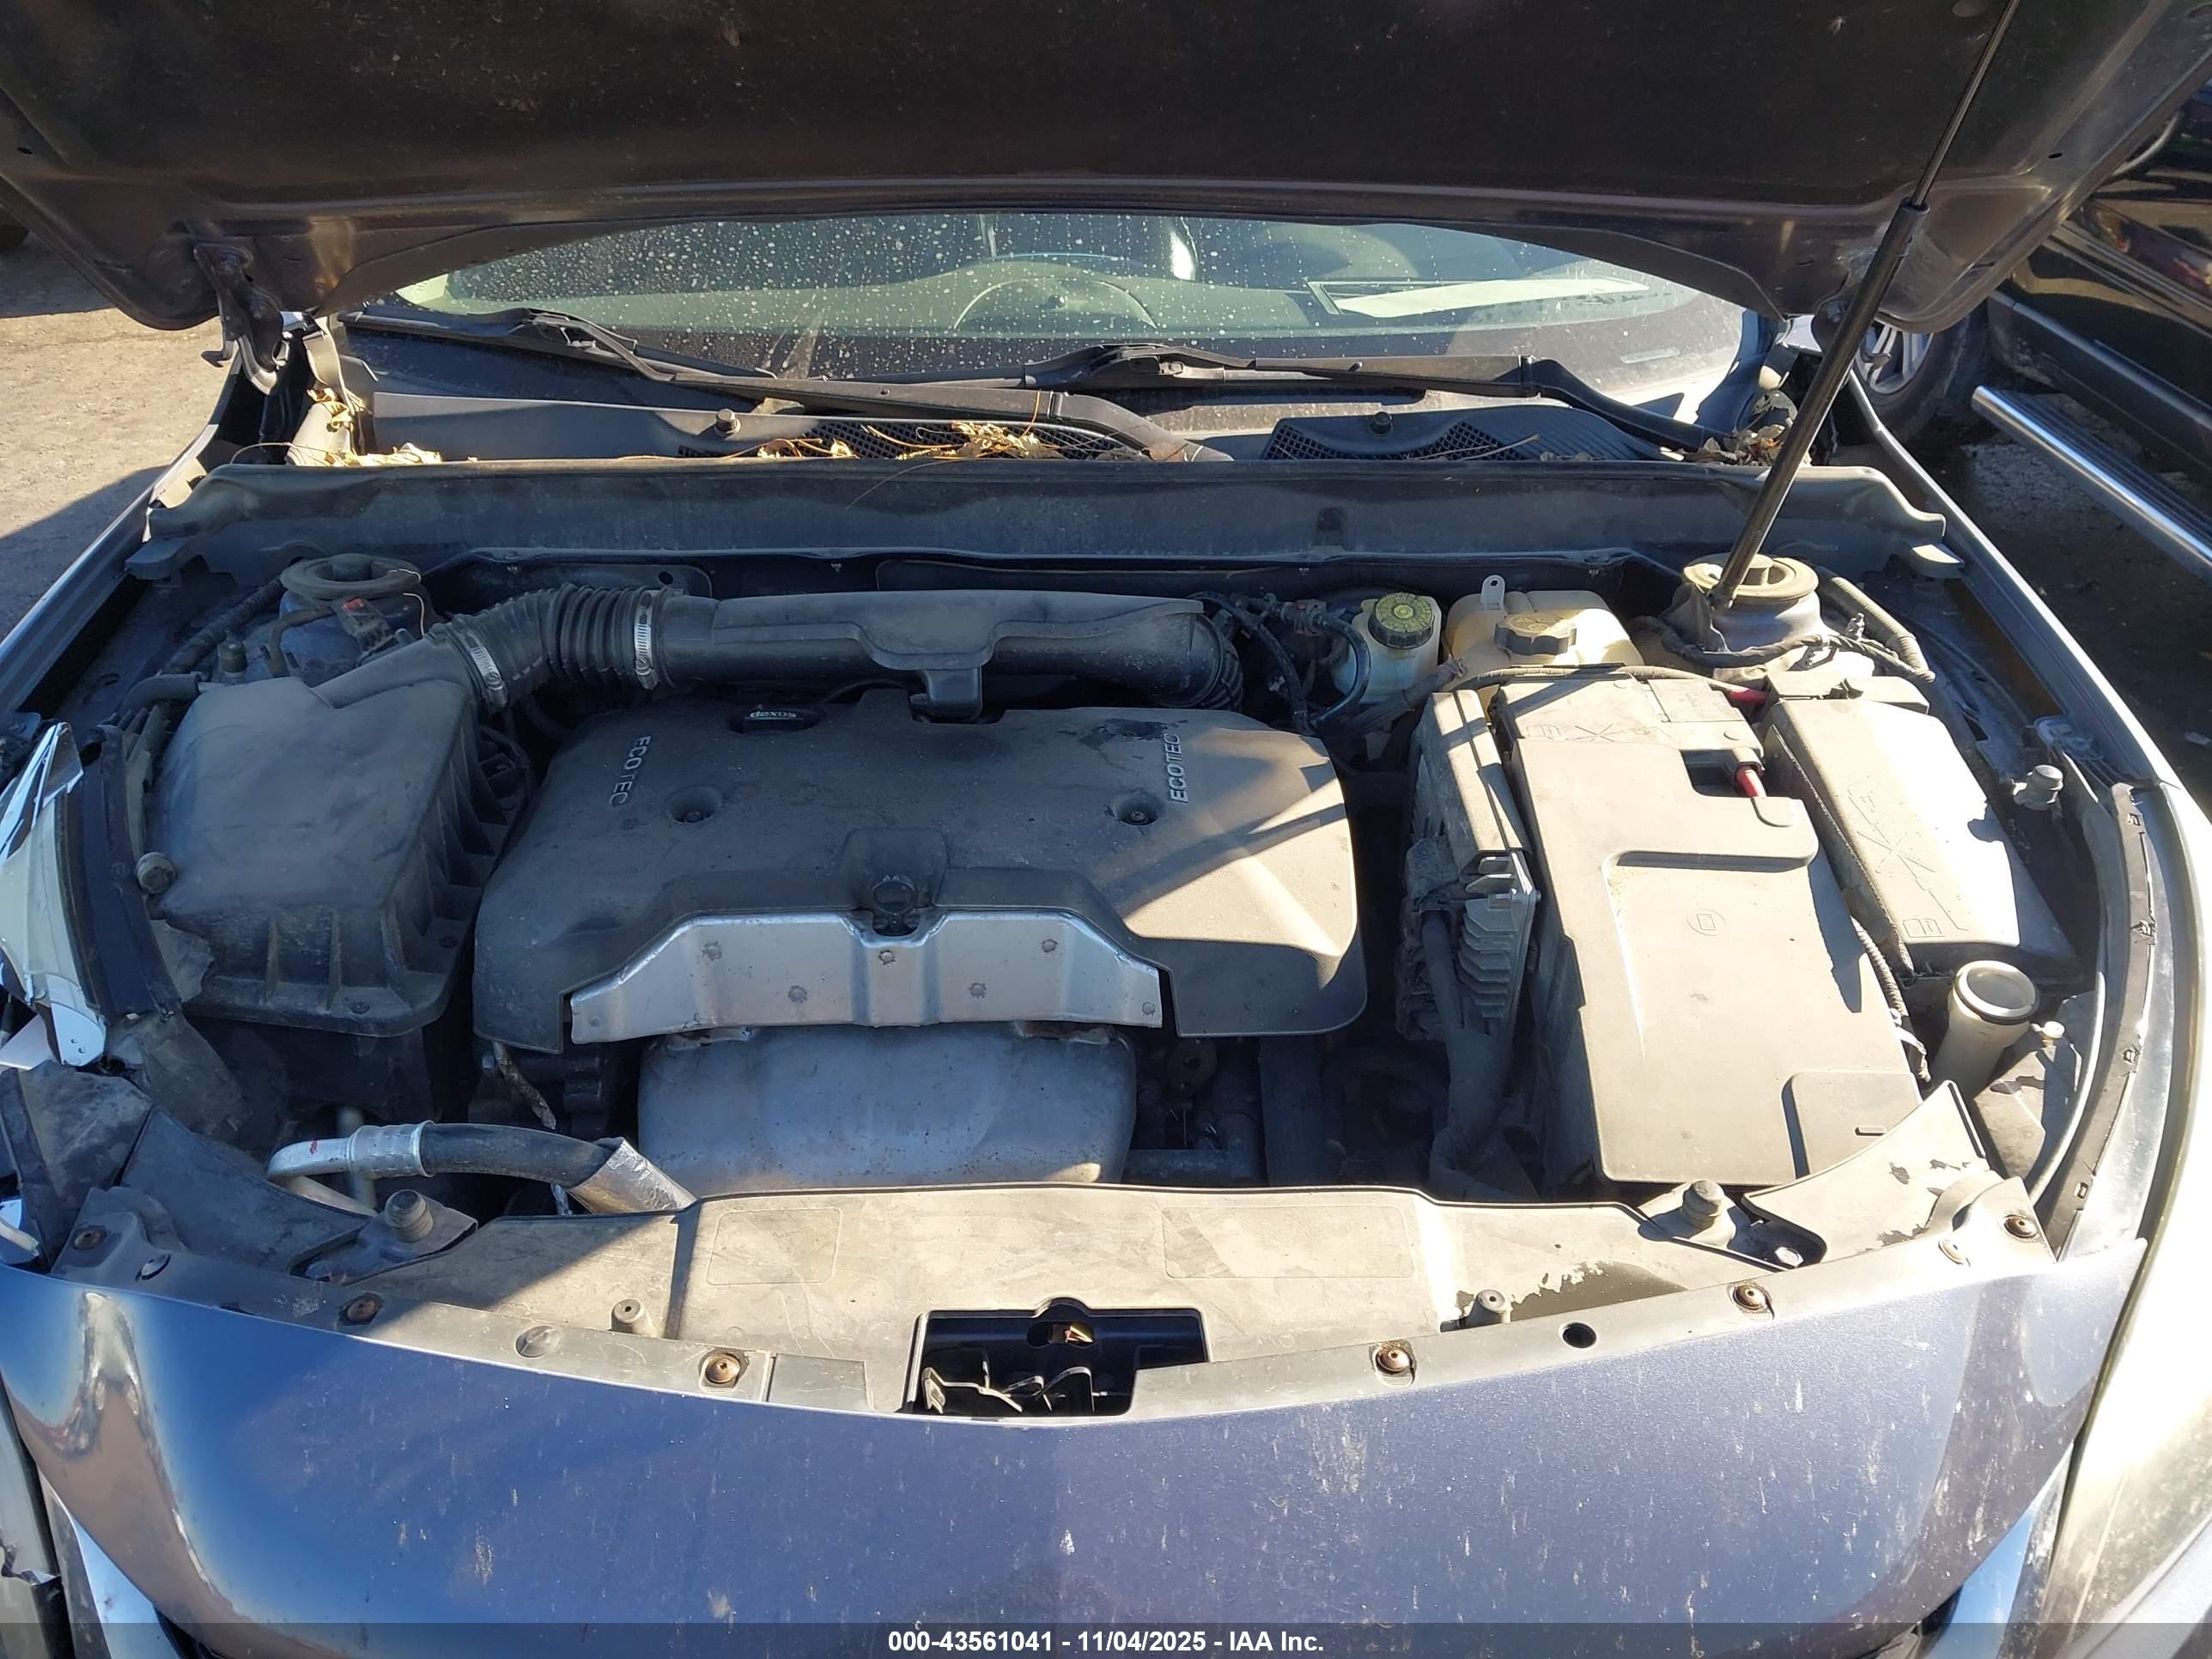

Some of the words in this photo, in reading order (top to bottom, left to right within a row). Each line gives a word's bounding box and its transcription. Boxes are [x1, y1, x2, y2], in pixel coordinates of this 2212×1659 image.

[749, 709, 798, 719] dexos
[609, 735, 652, 805] ECOTEC
[1163, 732, 1189, 804] ECOTEC
